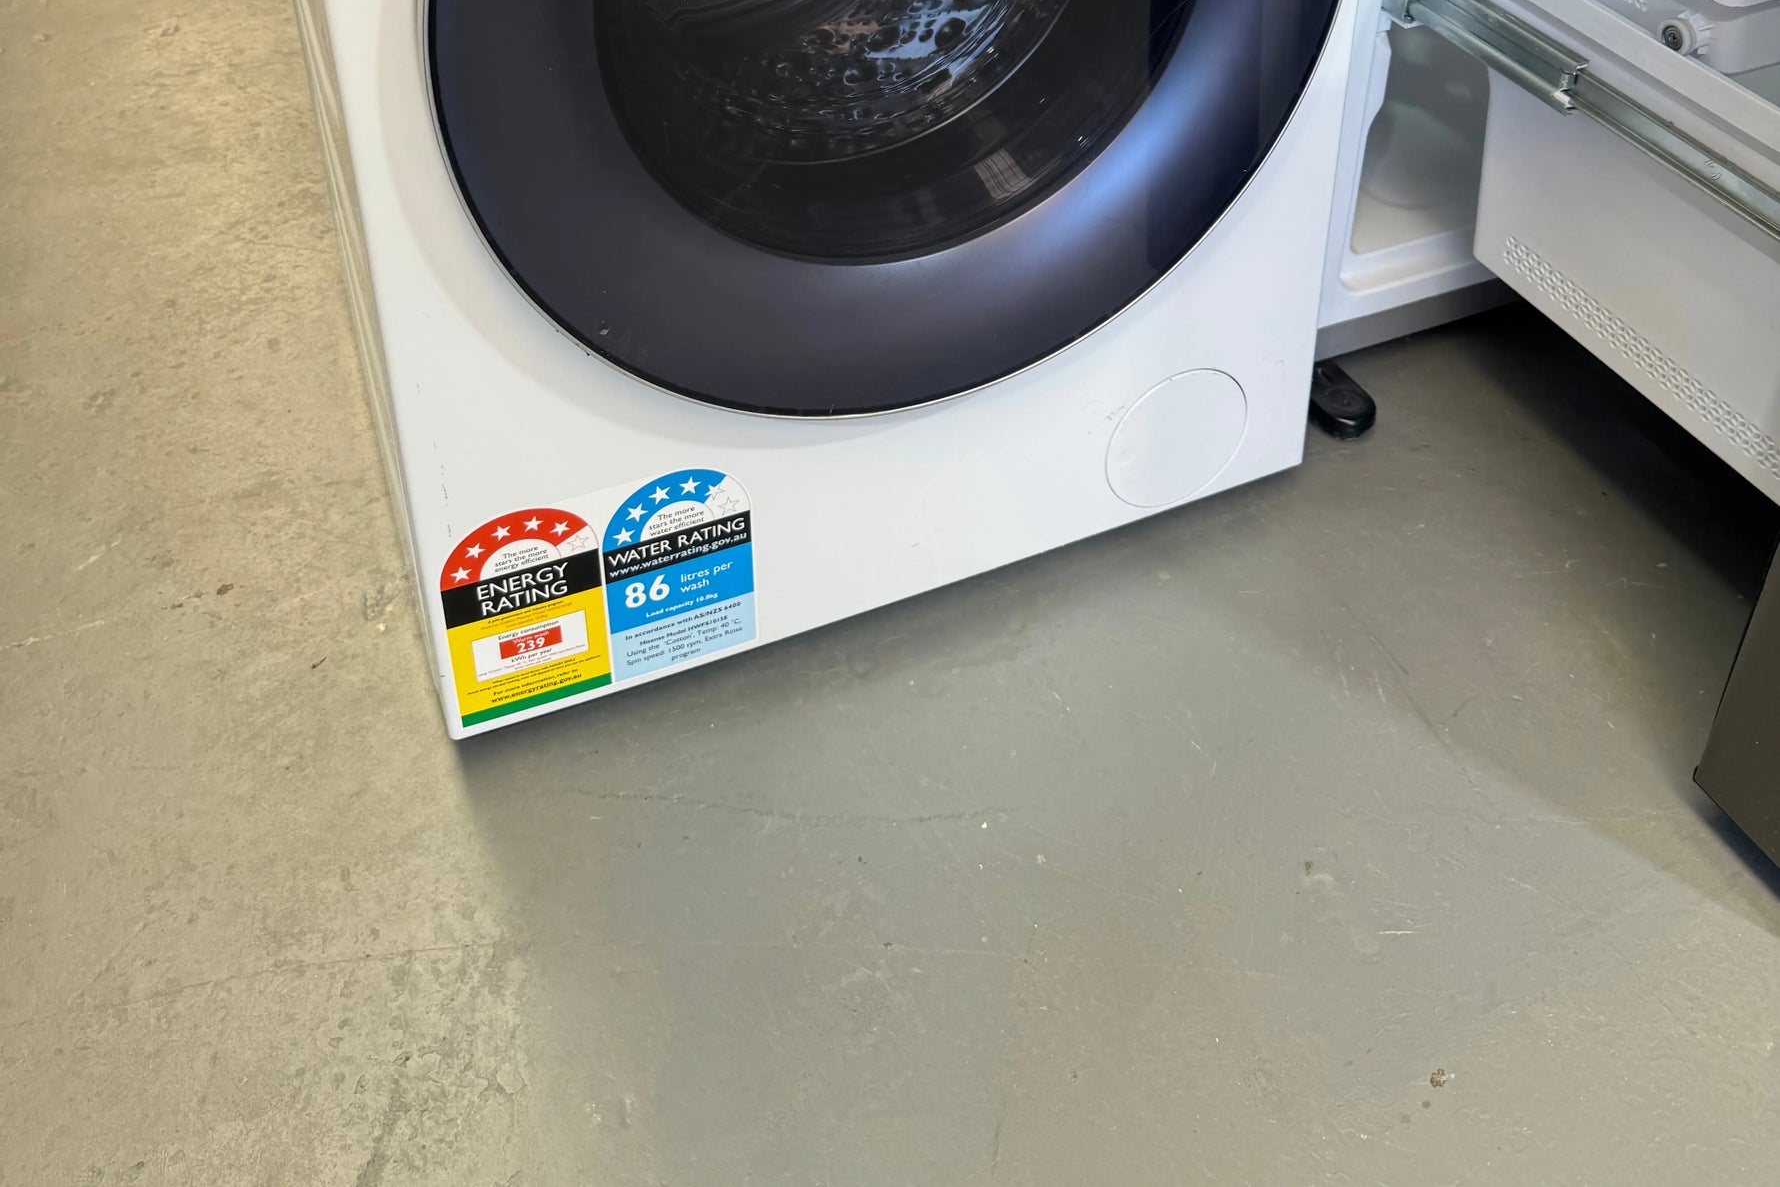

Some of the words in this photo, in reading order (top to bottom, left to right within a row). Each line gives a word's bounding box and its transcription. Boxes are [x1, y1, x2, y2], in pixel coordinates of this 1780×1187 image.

[648, 522, 668, 531] stars
[669, 517, 682, 525] the
[684, 510, 704, 520] more
[658, 513, 673, 521] The
[675, 506, 695, 515] more
[649, 528, 673, 537] water
[674, 517, 705, 530] efficient
[519, 546, 539, 554] more
[608, 539, 673, 567] WATER
[677, 517, 746, 548] RATING
[494, 563, 519, 573] energy
[521, 554, 549, 566] efficient
[495, 558, 512, 567] stars
[514, 554, 526, 562] the
[528, 549, 547, 558] more
[609, 532, 748, 578] www.waterrating.gov.au
[476, 561, 569, 601] ENERGY
[680, 568, 710, 583] litres
[713, 561, 734, 575] per
[624, 573, 670, 608] 86
[680, 579, 710, 593] wash
[481, 579, 568, 616] RATING
[645, 608, 664, 618] Load
[665, 600, 694, 612] capacity
[634, 622, 675, 638] accordance
[724, 601, 742, 610] 6400
[498, 630, 519, 641] Energy
[520, 620, 560, 634] consumption
[513, 635, 533, 644] Warm
[534, 631, 550, 639] wash
[640, 635, 665, 645] Hisense
[666, 628, 686, 637] Model
[516, 636, 546, 654] 239
[626, 657, 642, 666] Spin
[668, 643, 685, 653] 1500
[704, 633, 723, 642] Extra
[724, 626, 743, 636] Rinse
[627, 647, 647, 657] Using
[671, 648, 701, 661] program
[511, 655, 527, 663] kWh
[528, 651, 538, 660] per
[539, 648, 552, 656] year
[491, 673, 582, 704] www.energyrating.gov.au
